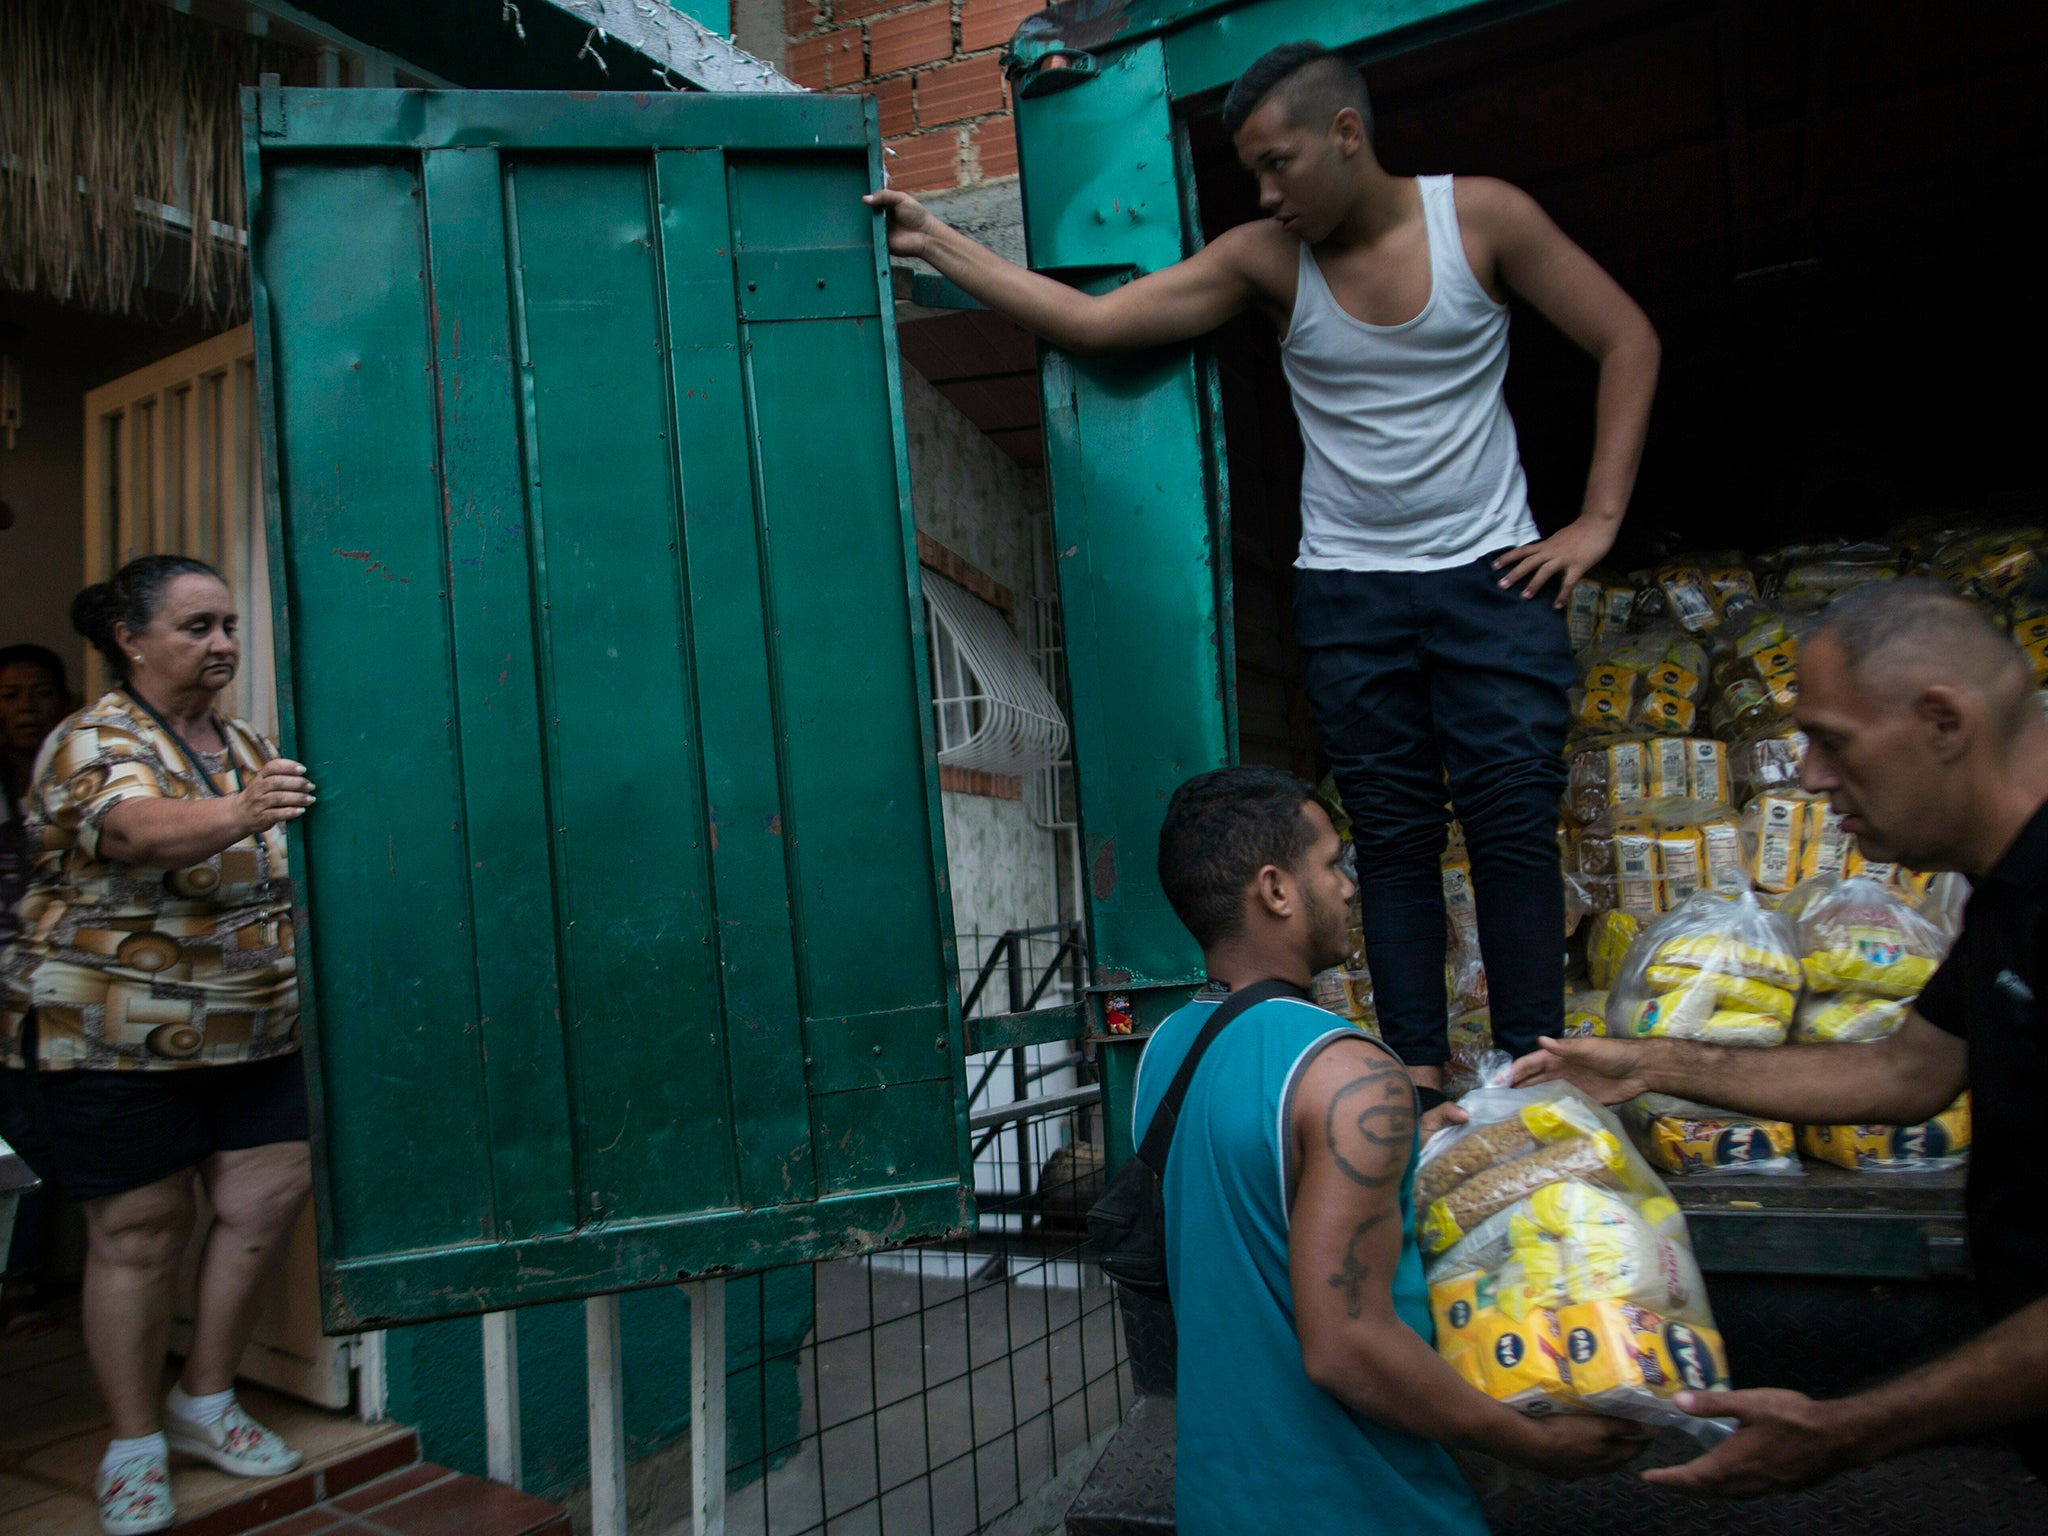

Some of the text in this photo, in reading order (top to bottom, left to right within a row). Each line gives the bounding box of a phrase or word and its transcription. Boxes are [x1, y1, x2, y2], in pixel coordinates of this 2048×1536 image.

[1500, 1335, 1517, 1365] PAN
[1573, 1329, 1591, 1360] PAN
[1672, 1323, 1707, 1390] PAN
